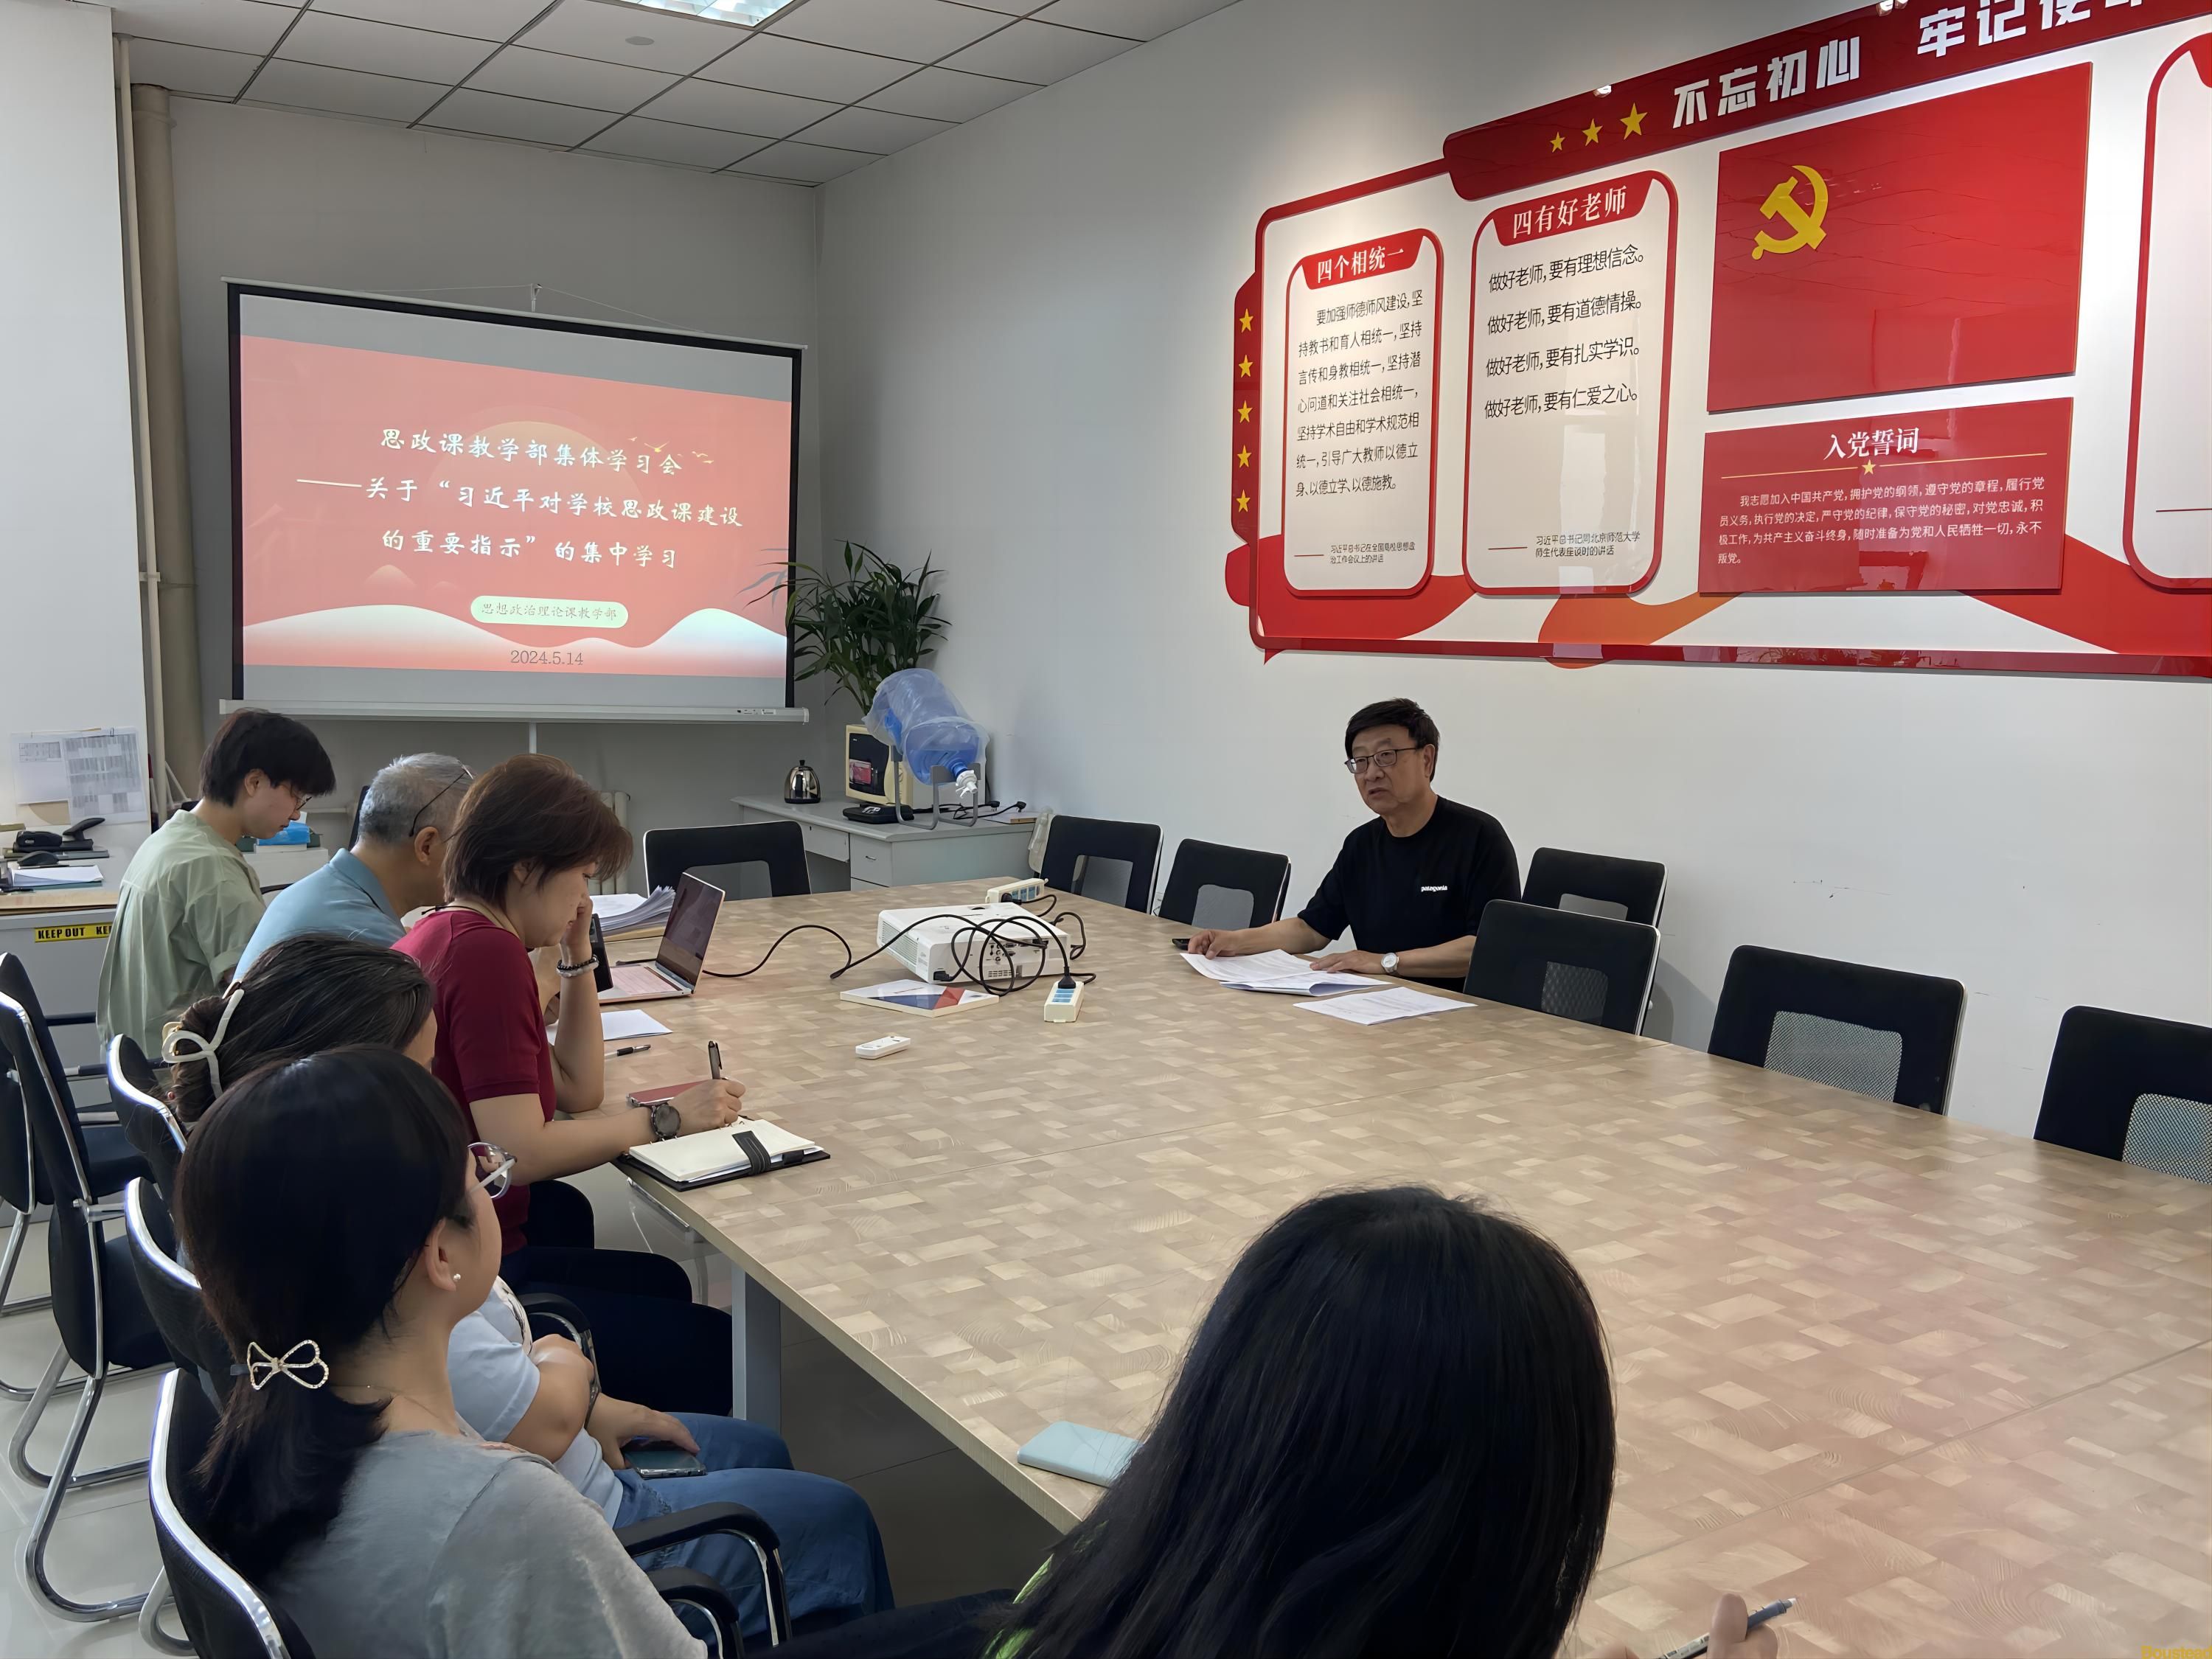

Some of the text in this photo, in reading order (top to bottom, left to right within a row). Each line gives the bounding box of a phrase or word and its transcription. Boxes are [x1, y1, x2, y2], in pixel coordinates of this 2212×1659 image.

[1672, 0, 2142, 128] 不忘初心 牢记使
[1512, 185, 1627, 239] 四有好老师
[1317, 246, 1404, 283] 四个相统一
[1489, 244, 1644, 293] 做好老师，要有理想信念。
[1316, 289, 1423, 326] 要加强师德师风建设，坚
[1487, 290, 1641, 335] 做好老师，要有道德情操。
[1298, 320, 1422, 358] 持教书和育人相统一，坚持
[1486, 336, 1639, 378] 做好老师，要有扎实学识。
[1298, 351, 1421, 385] 言传和身教相统一，坚持潜
[1297, 383, 1419, 414] 心问道和关注社会相统一，
[1484, 383, 1638, 420] 做好老师，要有仁爱之心。
[1296, 411, 1419, 442] 坚持学术自由和学术规范相
[1823, 427, 1919, 461] 入党誓词
[380, 428, 682, 476] 思政课教学部集体学习会
[1295, 442, 1419, 469] 统一，引导广大教师以德立
[1295, 474, 1397, 498] 身、以德立学、以德施教。
[481, 602, 616, 621] 思想政治理论课教学部
[510, 650, 584, 666] 2024.5.14
[38, 929, 63, 939] KEEP
[65, 927, 86, 937] OUT
